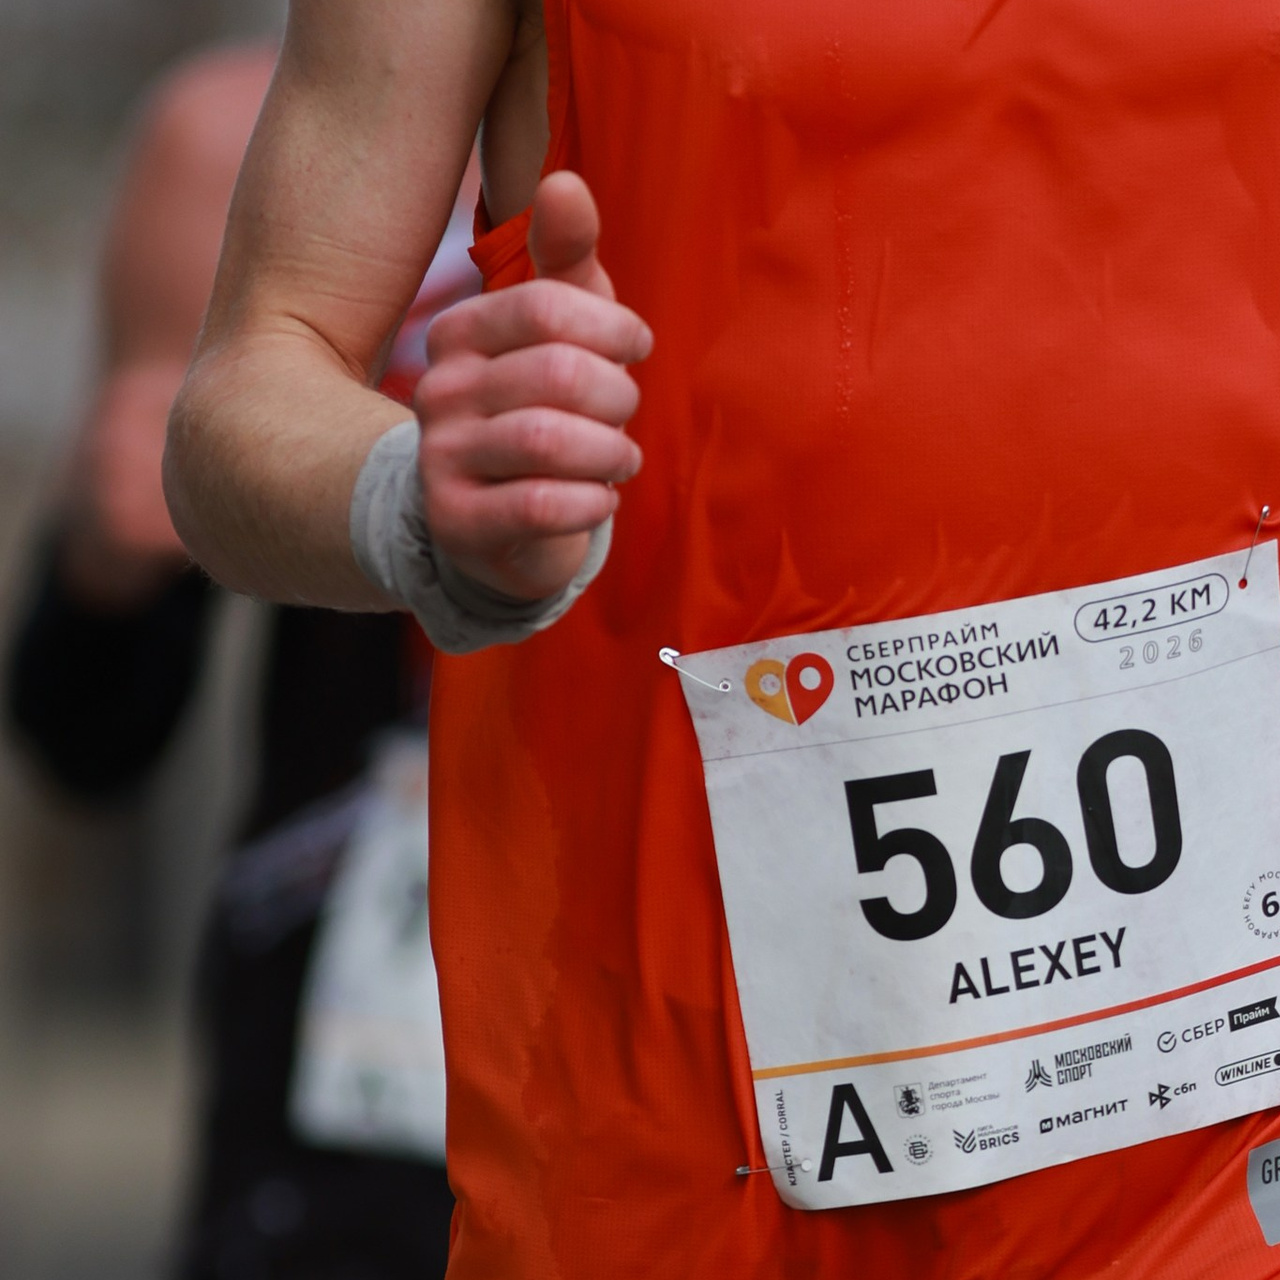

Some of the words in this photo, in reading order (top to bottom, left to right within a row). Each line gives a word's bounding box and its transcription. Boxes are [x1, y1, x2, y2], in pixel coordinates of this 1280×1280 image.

[1095, 599, 1156, 630] 42,2
[1171, 584, 1210, 615] КМ
[846, 622, 998, 662] СБЕРПРАЙМ
[850, 632, 1059, 690] МОСКОВСКИЙ
[1120, 628, 1202, 670] 2026
[855, 673, 1008, 718] МАРАФОН
[844, 729, 1182, 941] 560
[1262, 892, 1280, 917] 6
[949, 927, 1126, 1004] ALEXEY
[1182, 1018, 1224, 1042] СБЕР
[1233, 1006, 1270, 1025] Прайм
[1055, 1034, 1132, 1068] МОСКОВСКИЙ
[1219, 1058, 1270, 1081] WINLINE
[928, 1073, 987, 1090] Департамент
[1057, 1063, 1092, 1085] СПОРТ
[775, 1090, 789, 1130] CORRAL
[930, 1089, 961, 1100] спорта
[978, 1132, 1019, 1150] BRICS
